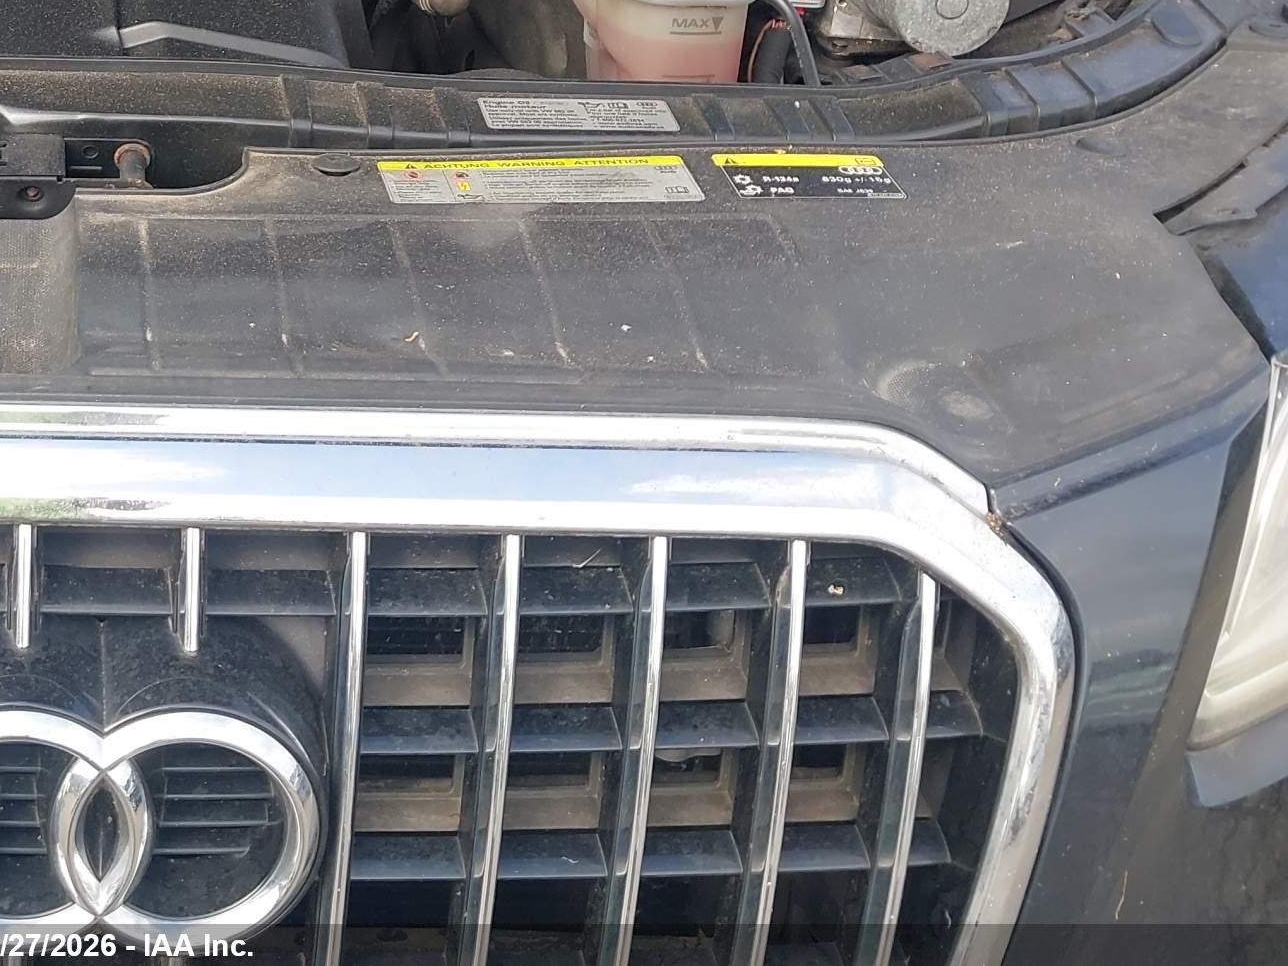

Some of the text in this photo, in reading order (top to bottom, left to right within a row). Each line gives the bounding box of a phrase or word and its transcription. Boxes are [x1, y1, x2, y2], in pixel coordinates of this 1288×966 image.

[671, 17, 710, 28] MAX
[423, 158, 650, 170] ACHTUNG WARNING ATTENTION
